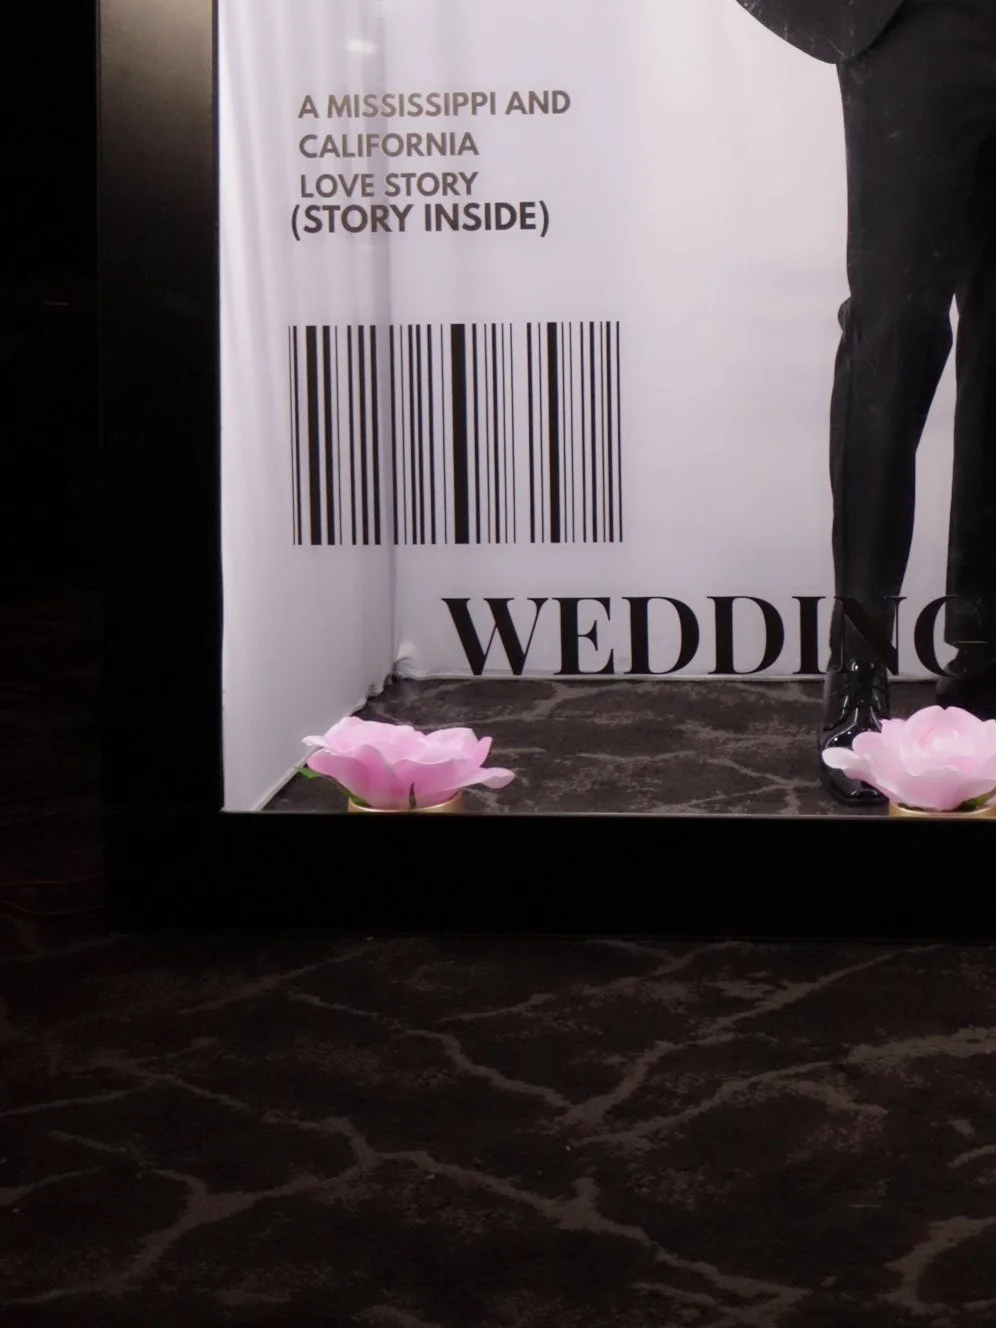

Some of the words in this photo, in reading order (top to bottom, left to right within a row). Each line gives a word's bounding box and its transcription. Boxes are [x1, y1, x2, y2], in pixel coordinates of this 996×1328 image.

[297, 94, 320, 119] A
[326, 91, 497, 118] MISSISSIPPI
[504, 89, 572, 116] AND
[298, 131, 480, 159] CALIFORNIA
[299, 173, 375, 199] LOVE
[383, 171, 480, 198] STORY
[290, 202, 415, 242] (STORY
[424, 199, 551, 239] INSIDE)
